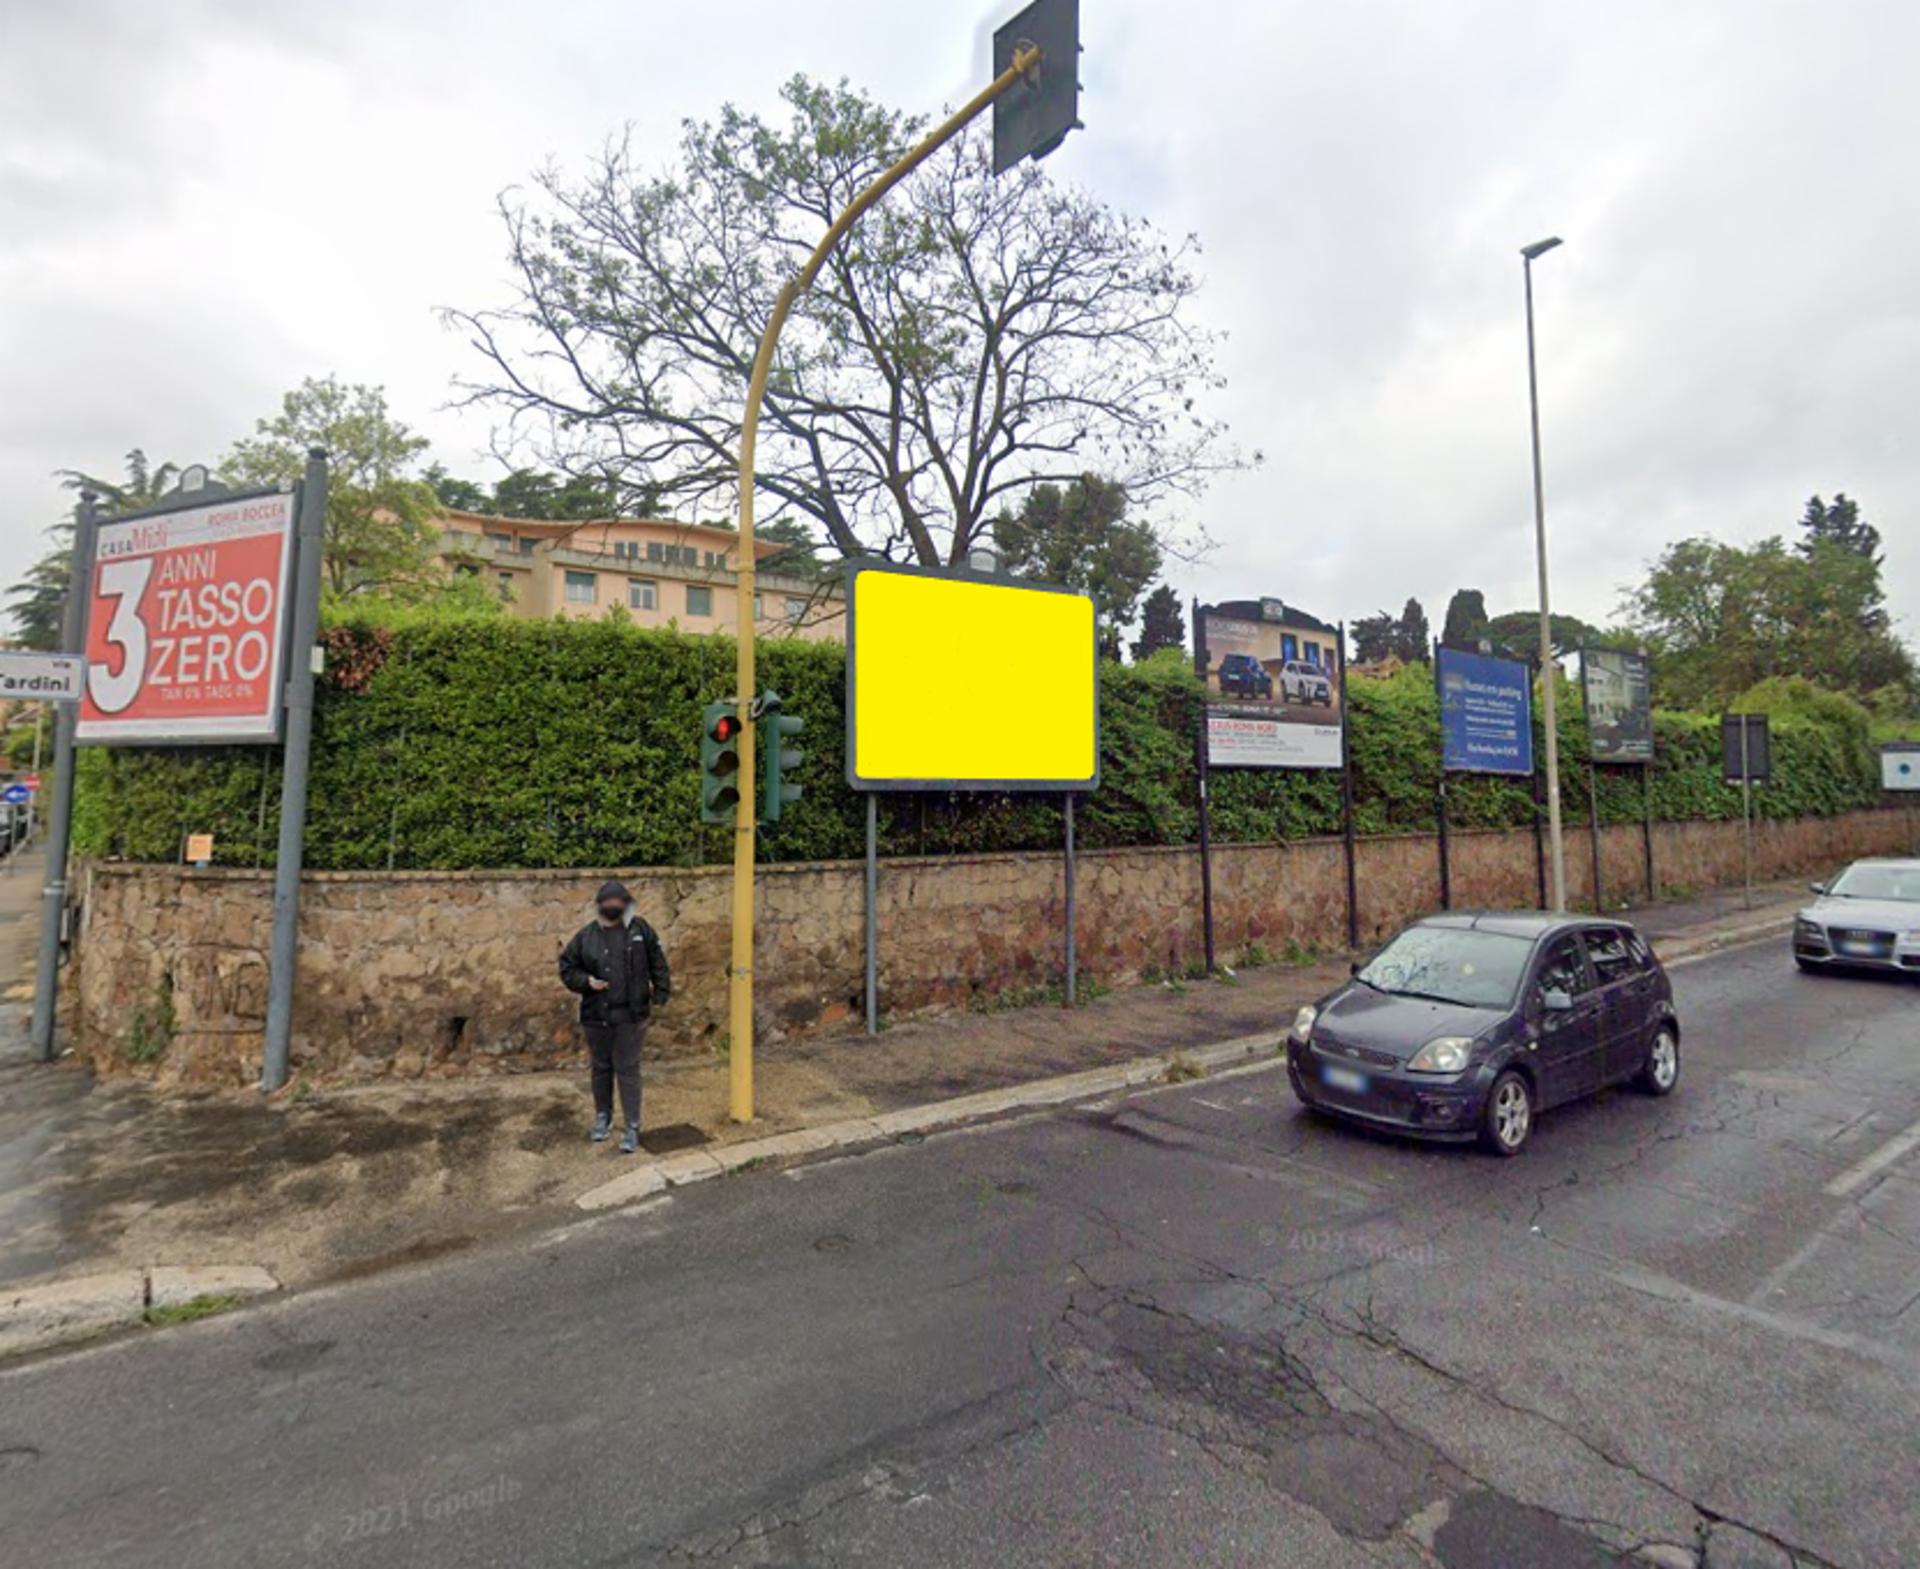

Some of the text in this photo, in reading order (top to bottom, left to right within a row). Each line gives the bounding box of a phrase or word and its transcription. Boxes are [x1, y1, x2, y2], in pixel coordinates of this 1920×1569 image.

[158, 550, 216, 585] ANNI
[157, 577, 273, 632] TASSO
[87, 556, 154, 714] 3
[148, 630, 268, 686] ZERO
